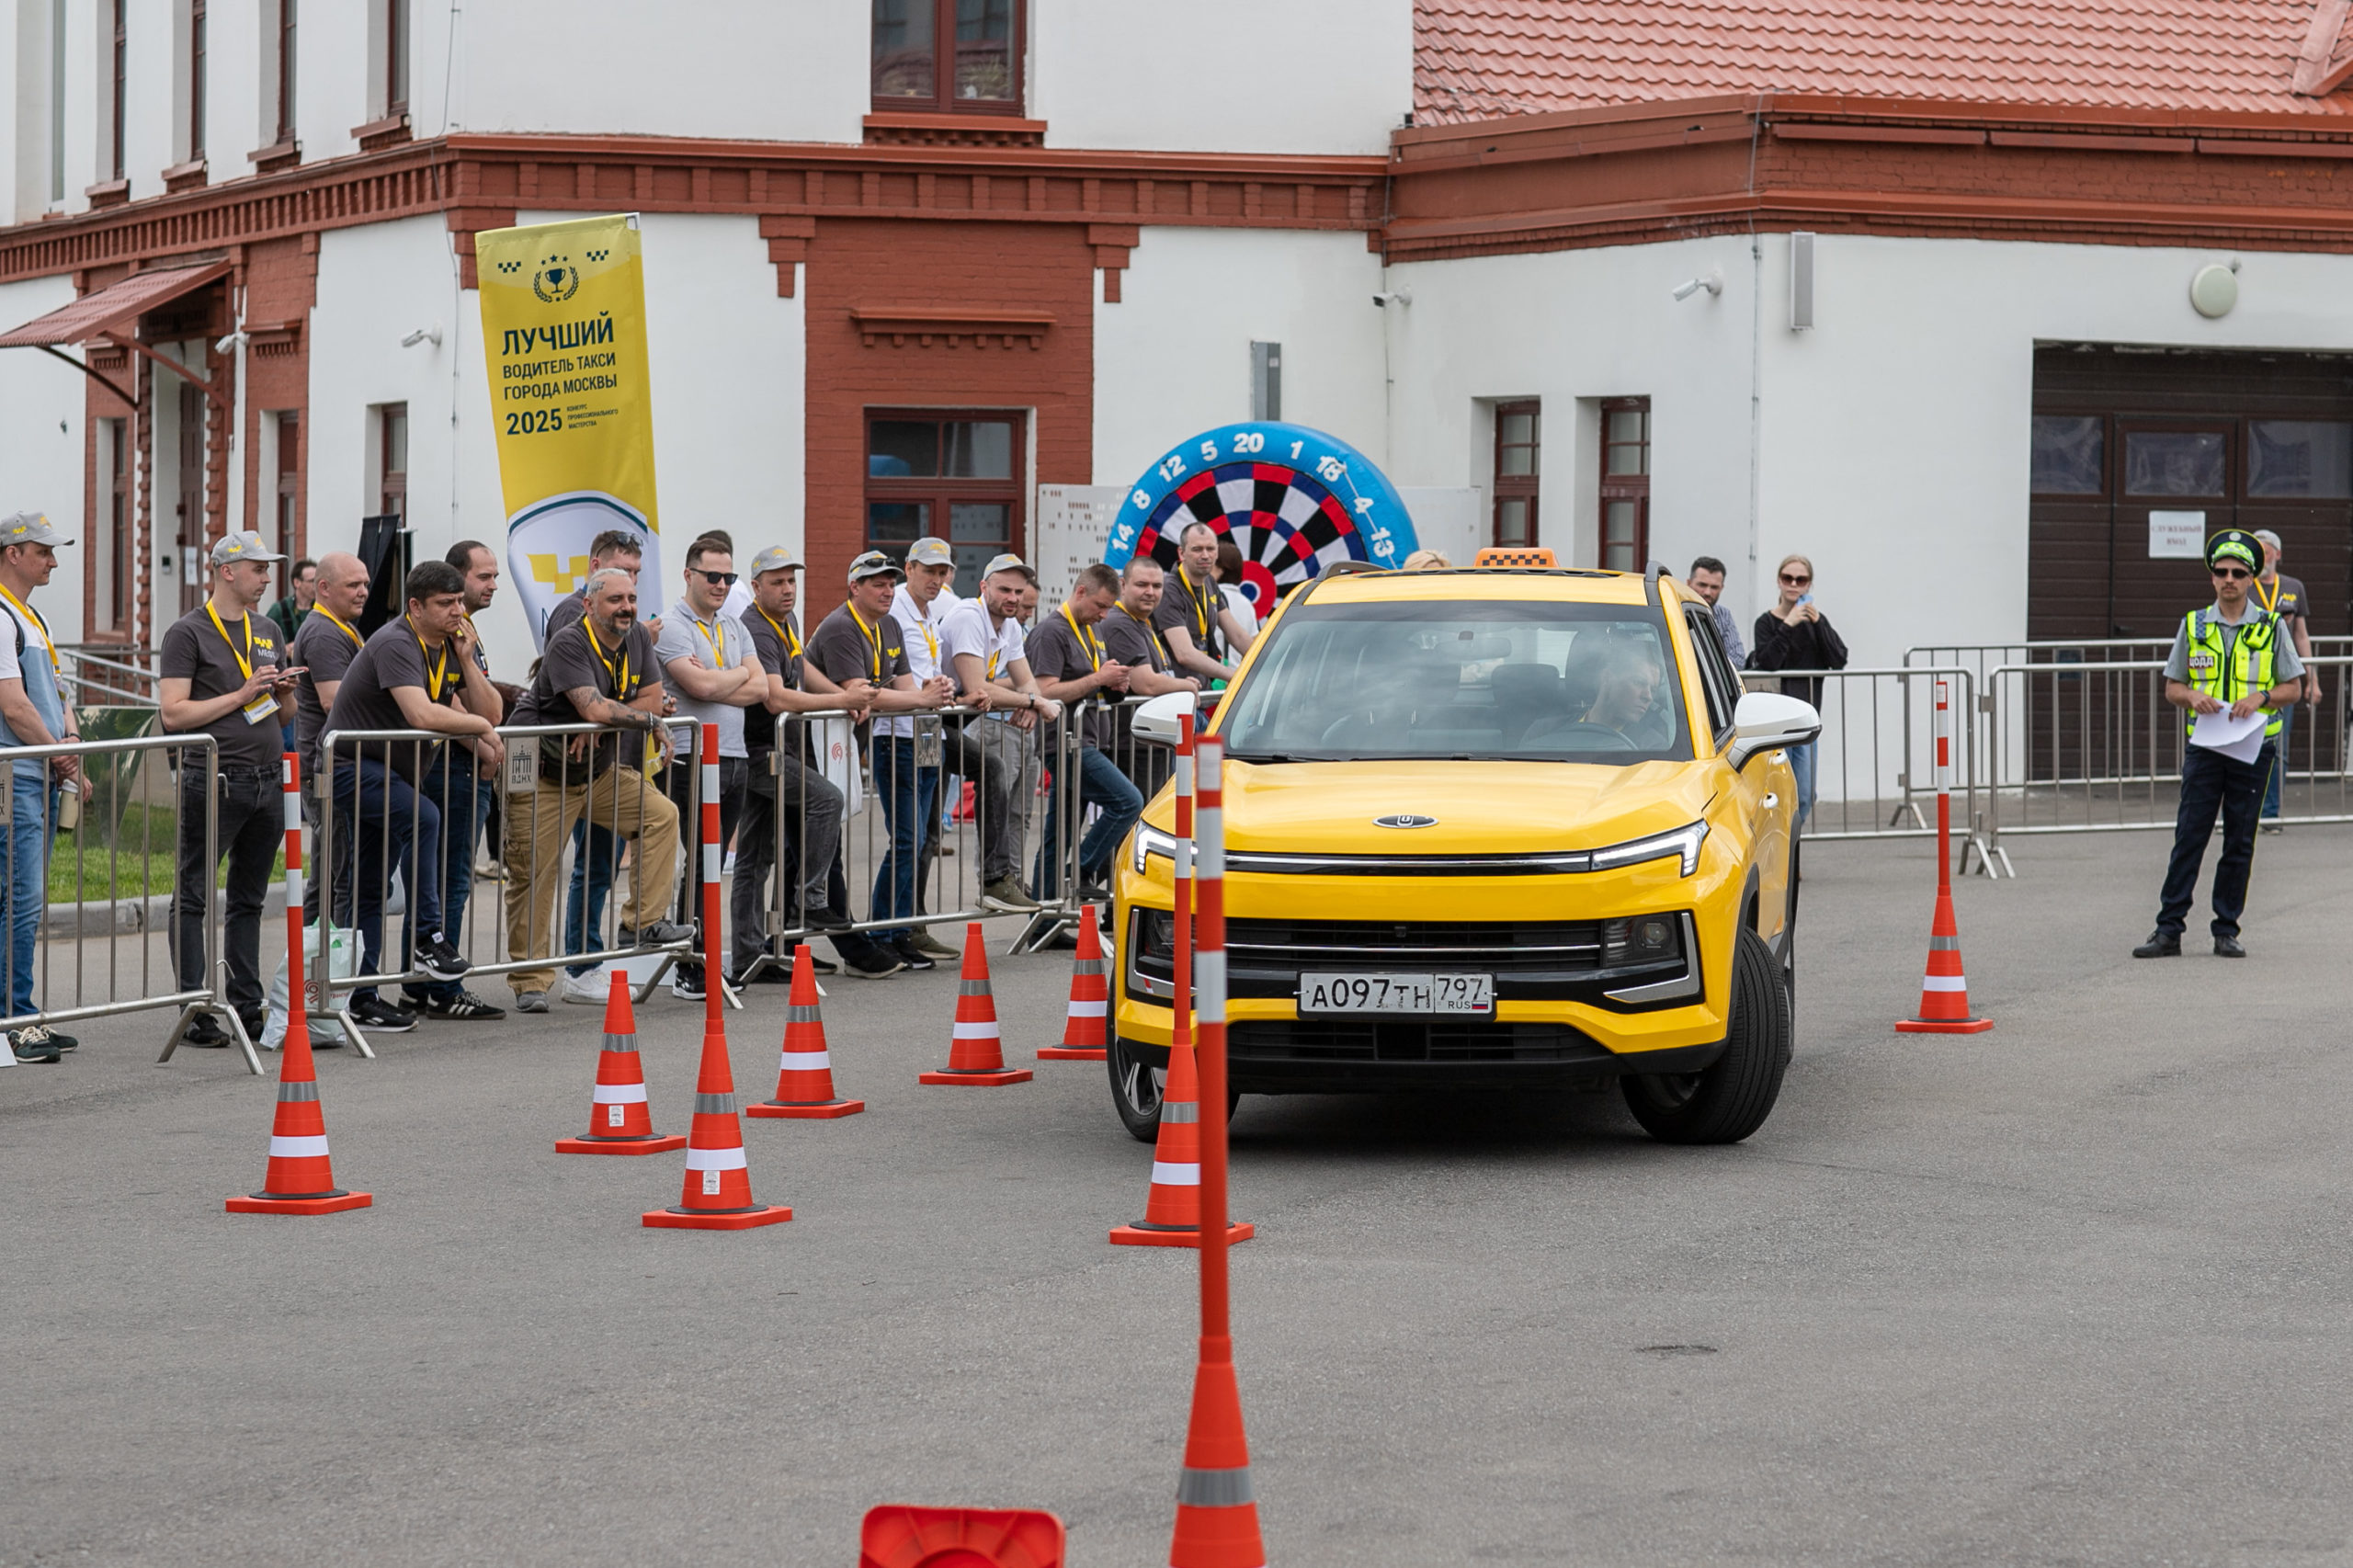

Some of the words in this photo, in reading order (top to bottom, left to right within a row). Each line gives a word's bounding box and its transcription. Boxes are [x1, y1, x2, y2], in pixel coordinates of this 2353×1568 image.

[502, 311, 615, 356] ЛУЧШИЙ
[503, 358, 574, 381] ВОДИТЕЛЬ
[576, 352, 617, 370] ТАКСИ
[504, 380, 561, 401] ГОРОДА
[563, 373, 618, 394] МОСКВЫ
[566, 403, 588, 412] КОНКУРС
[567, 409, 619, 420] ПРОФЕССИОНАЛЬНОГО
[506, 407, 563, 436] 2025
[568, 420, 597, 429] МАСТЕРСТВА
[1200, 439, 1219, 462] 5
[1233, 432, 1266, 454] 20
[1290, 440, 1304, 460] 1
[1158, 455, 1188, 483] 12
[1315, 455, 1343, 483] 18
[1131, 488, 1152, 510] 8
[1354, 496, 1374, 515] 4
[1111, 522, 1135, 551] 14
[1371, 527, 1395, 558] 13
[2189, 656, 2214, 668] ЦОДД
[1438, 977, 1484, 1001] 797
[1448, 1000, 1471, 1010] RUS
